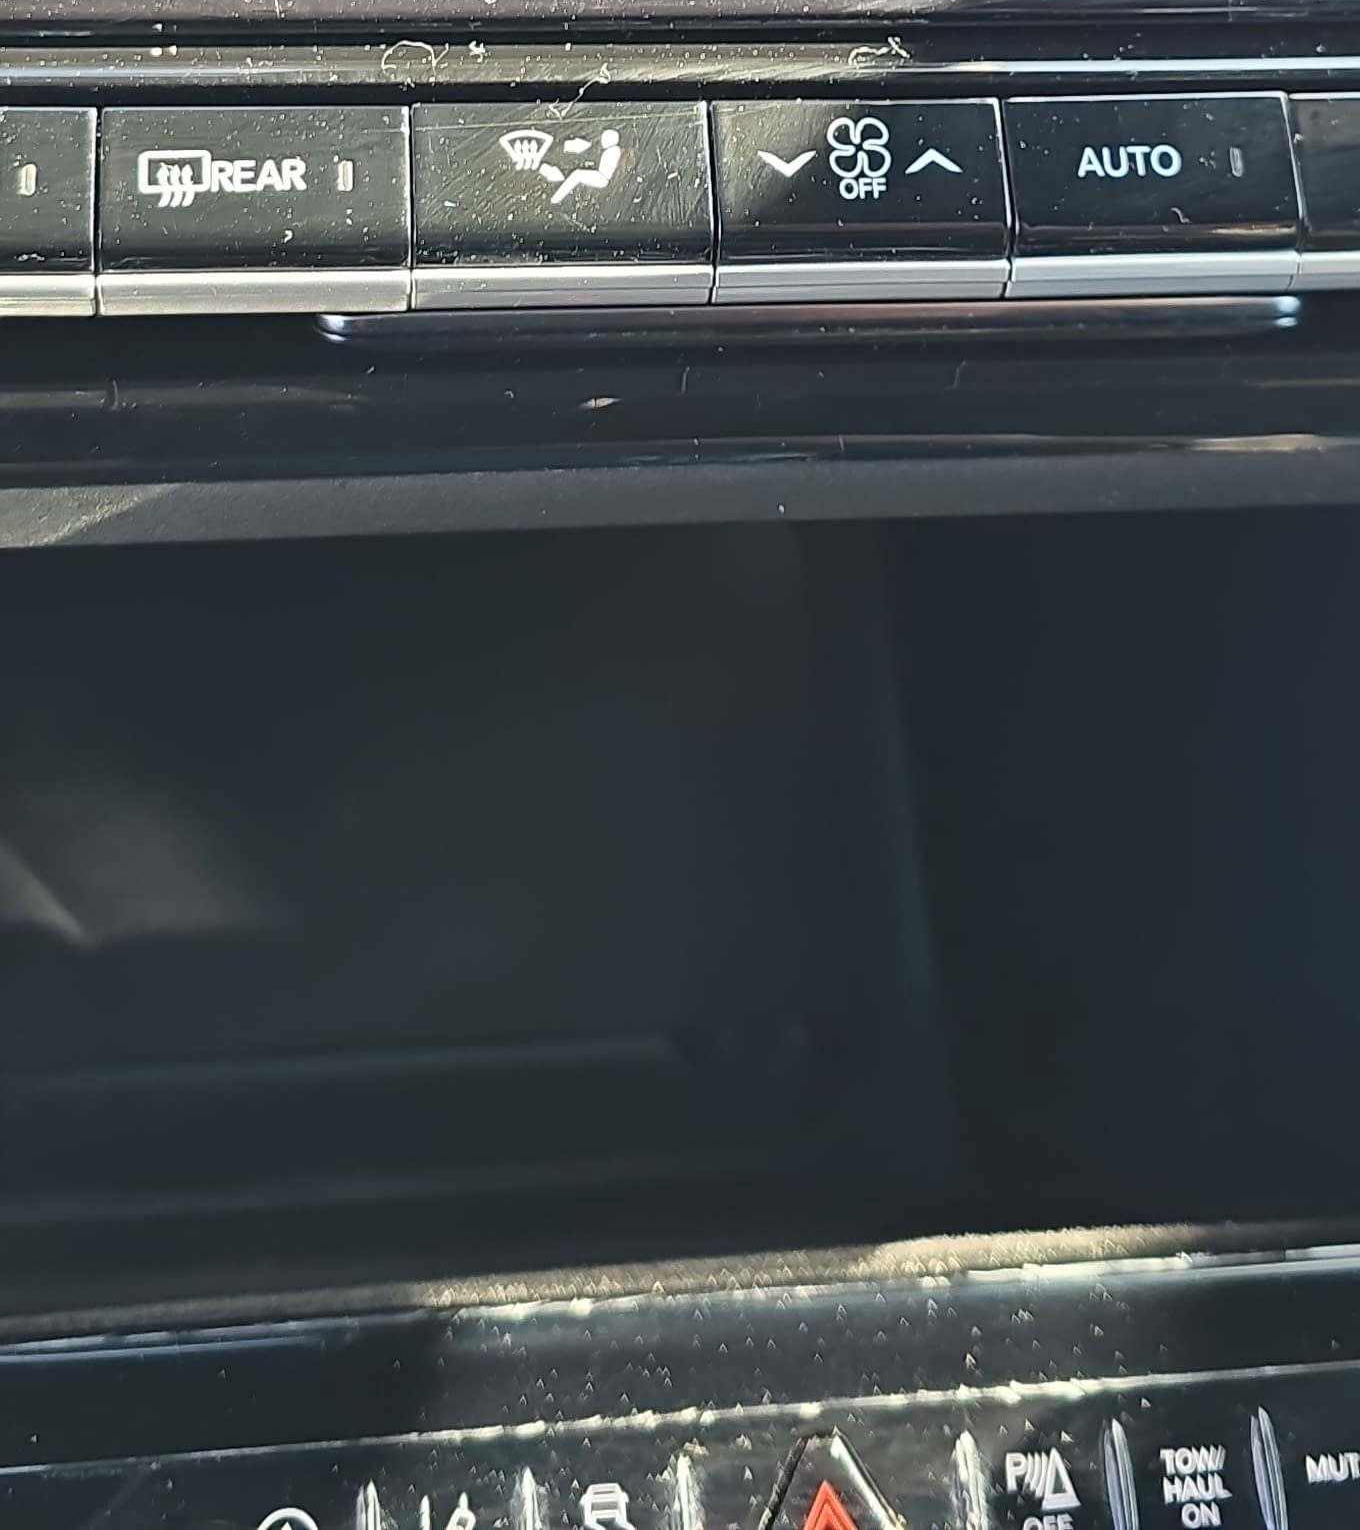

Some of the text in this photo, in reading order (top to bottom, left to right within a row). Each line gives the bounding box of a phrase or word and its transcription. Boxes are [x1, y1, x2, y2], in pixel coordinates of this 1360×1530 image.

[210, 158, 307, 193] REAR
[1077, 144, 1182, 178] AUTO
[840, 176, 887, 200] OFF
[1163, 1472, 1233, 1505] HAUL
[1181, 1501, 1222, 1528] ON
